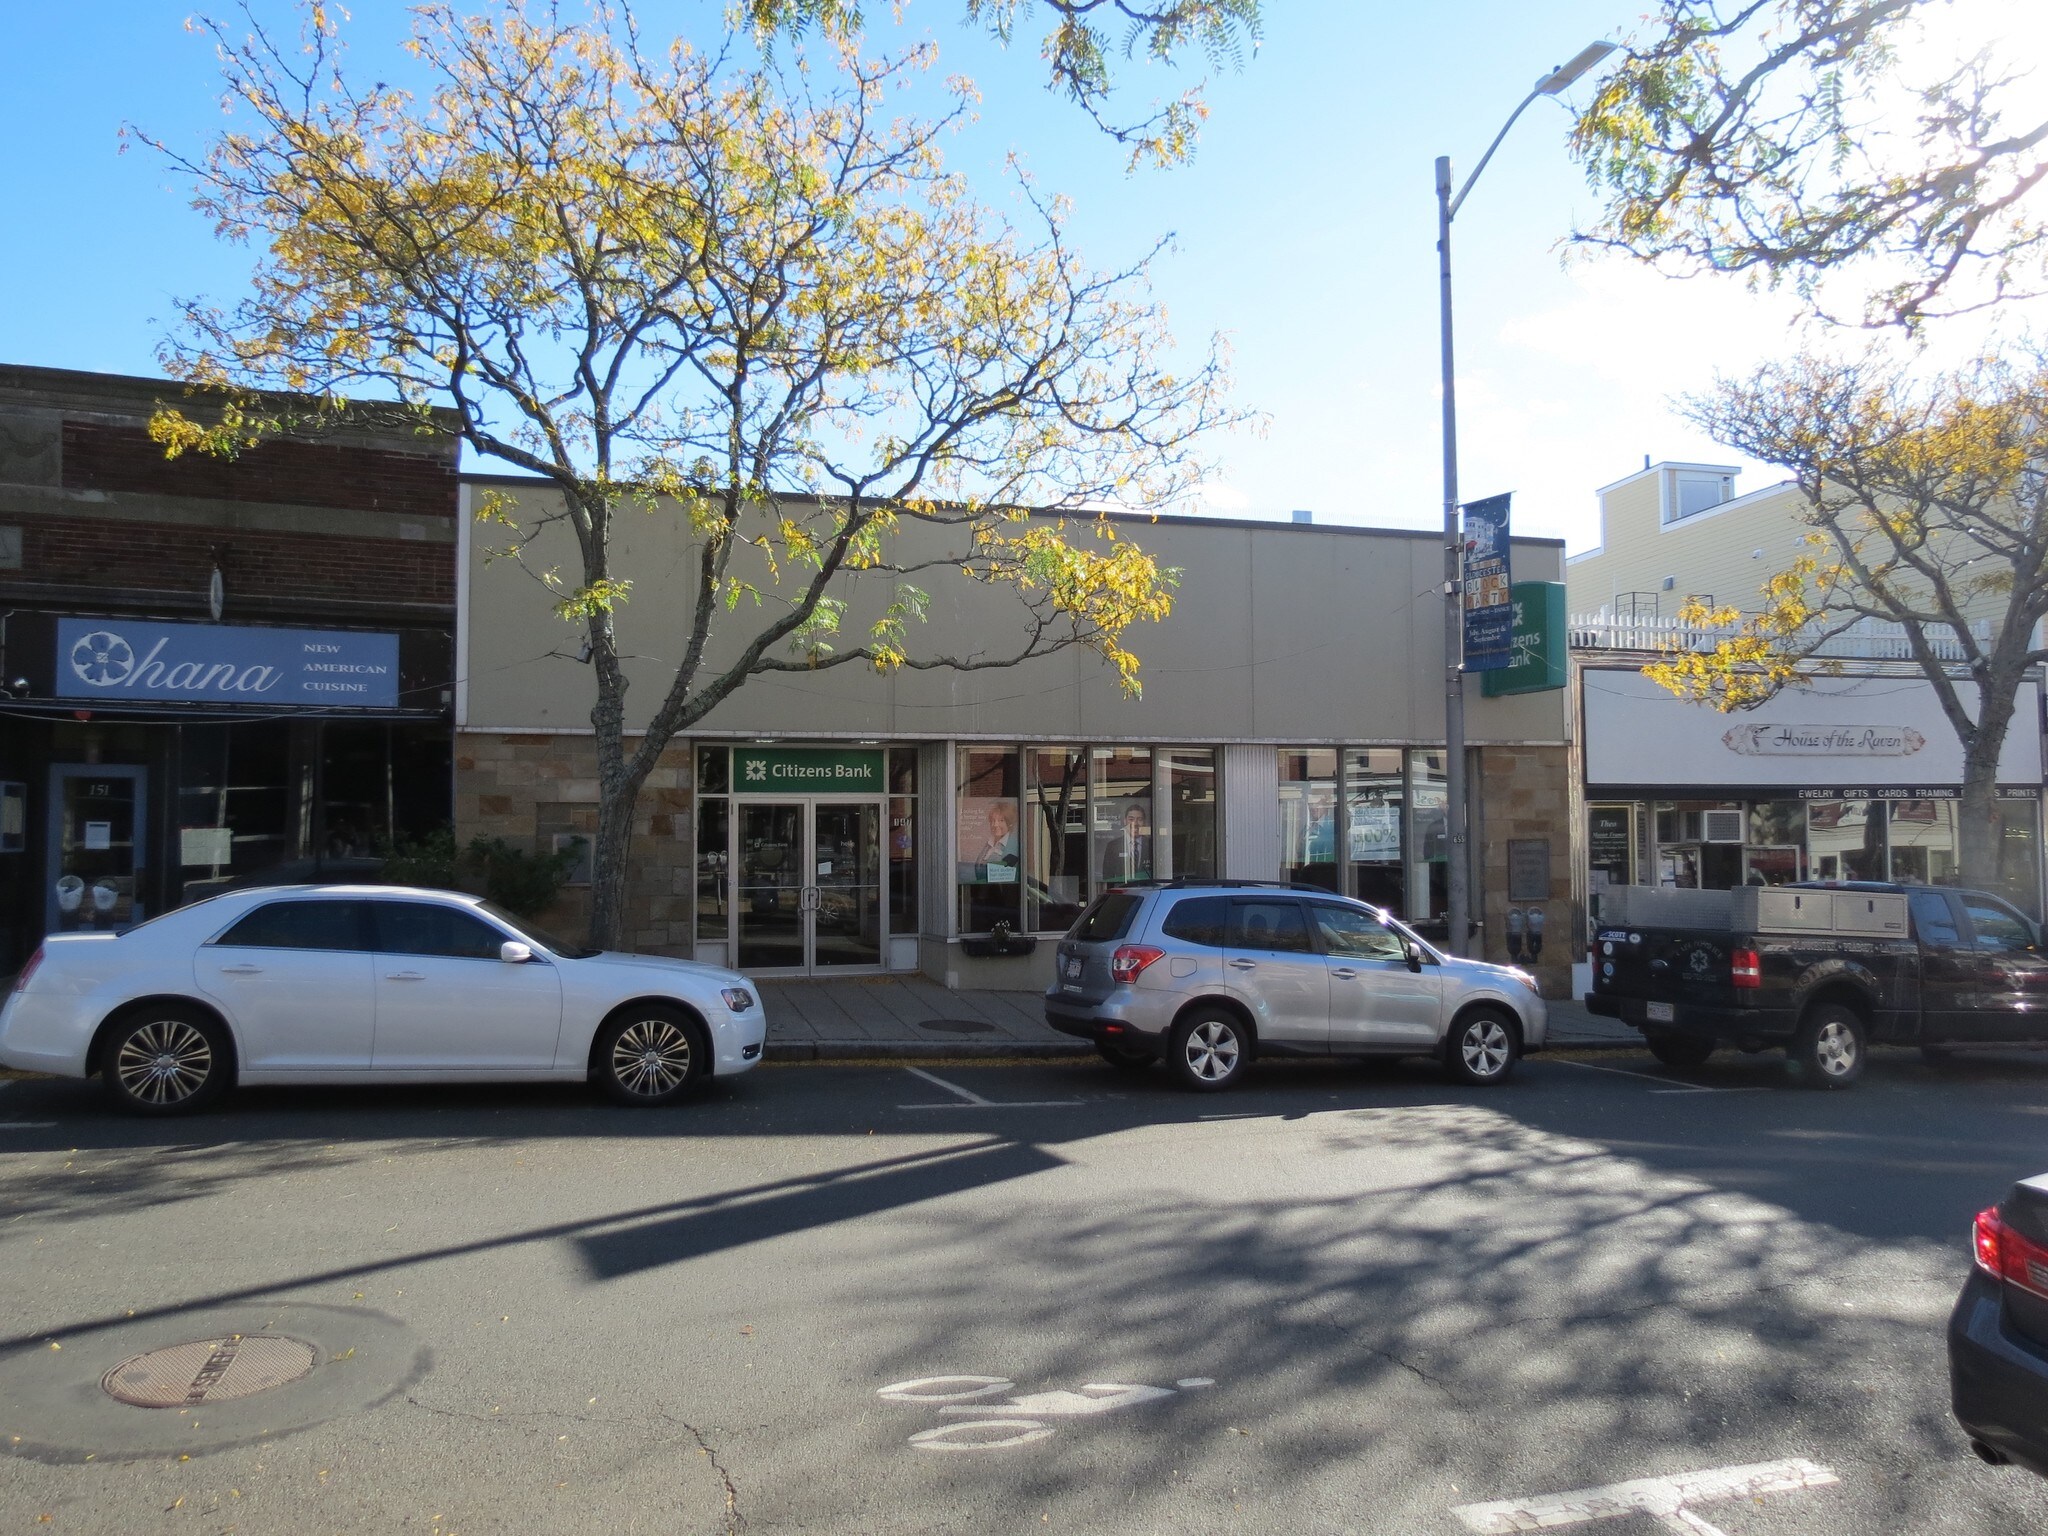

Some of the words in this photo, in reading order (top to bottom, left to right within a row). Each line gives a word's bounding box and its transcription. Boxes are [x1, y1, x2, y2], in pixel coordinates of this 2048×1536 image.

[1467, 575, 1507, 593] BLOCK
[1467, 590, 1507, 608] PARTY
[1510, 632, 1540, 648] zens
[304, 644, 341, 654] NEW
[1509, 650, 1531, 666] ank
[303, 663, 387, 674] AMERICAN
[303, 682, 368, 693] CUISINE
[1773, 729, 1819, 747] House
[1822, 730, 1837, 750] of
[1837, 730, 1855, 747] the
[1857, 729, 1901, 750] Raven
[772, 764, 832, 778] Citizens
[835, 764, 872, 778] Bank
[88, 783, 109, 796] 151
[1798, 789, 1834, 798] EWELRY
[1843, 789, 1869, 798] GIFTS
[1877, 789, 1909, 798] CARDS
[1915, 789, 1954, 798] FRAMING
[2006, 789, 2037, 798] PRINTS
